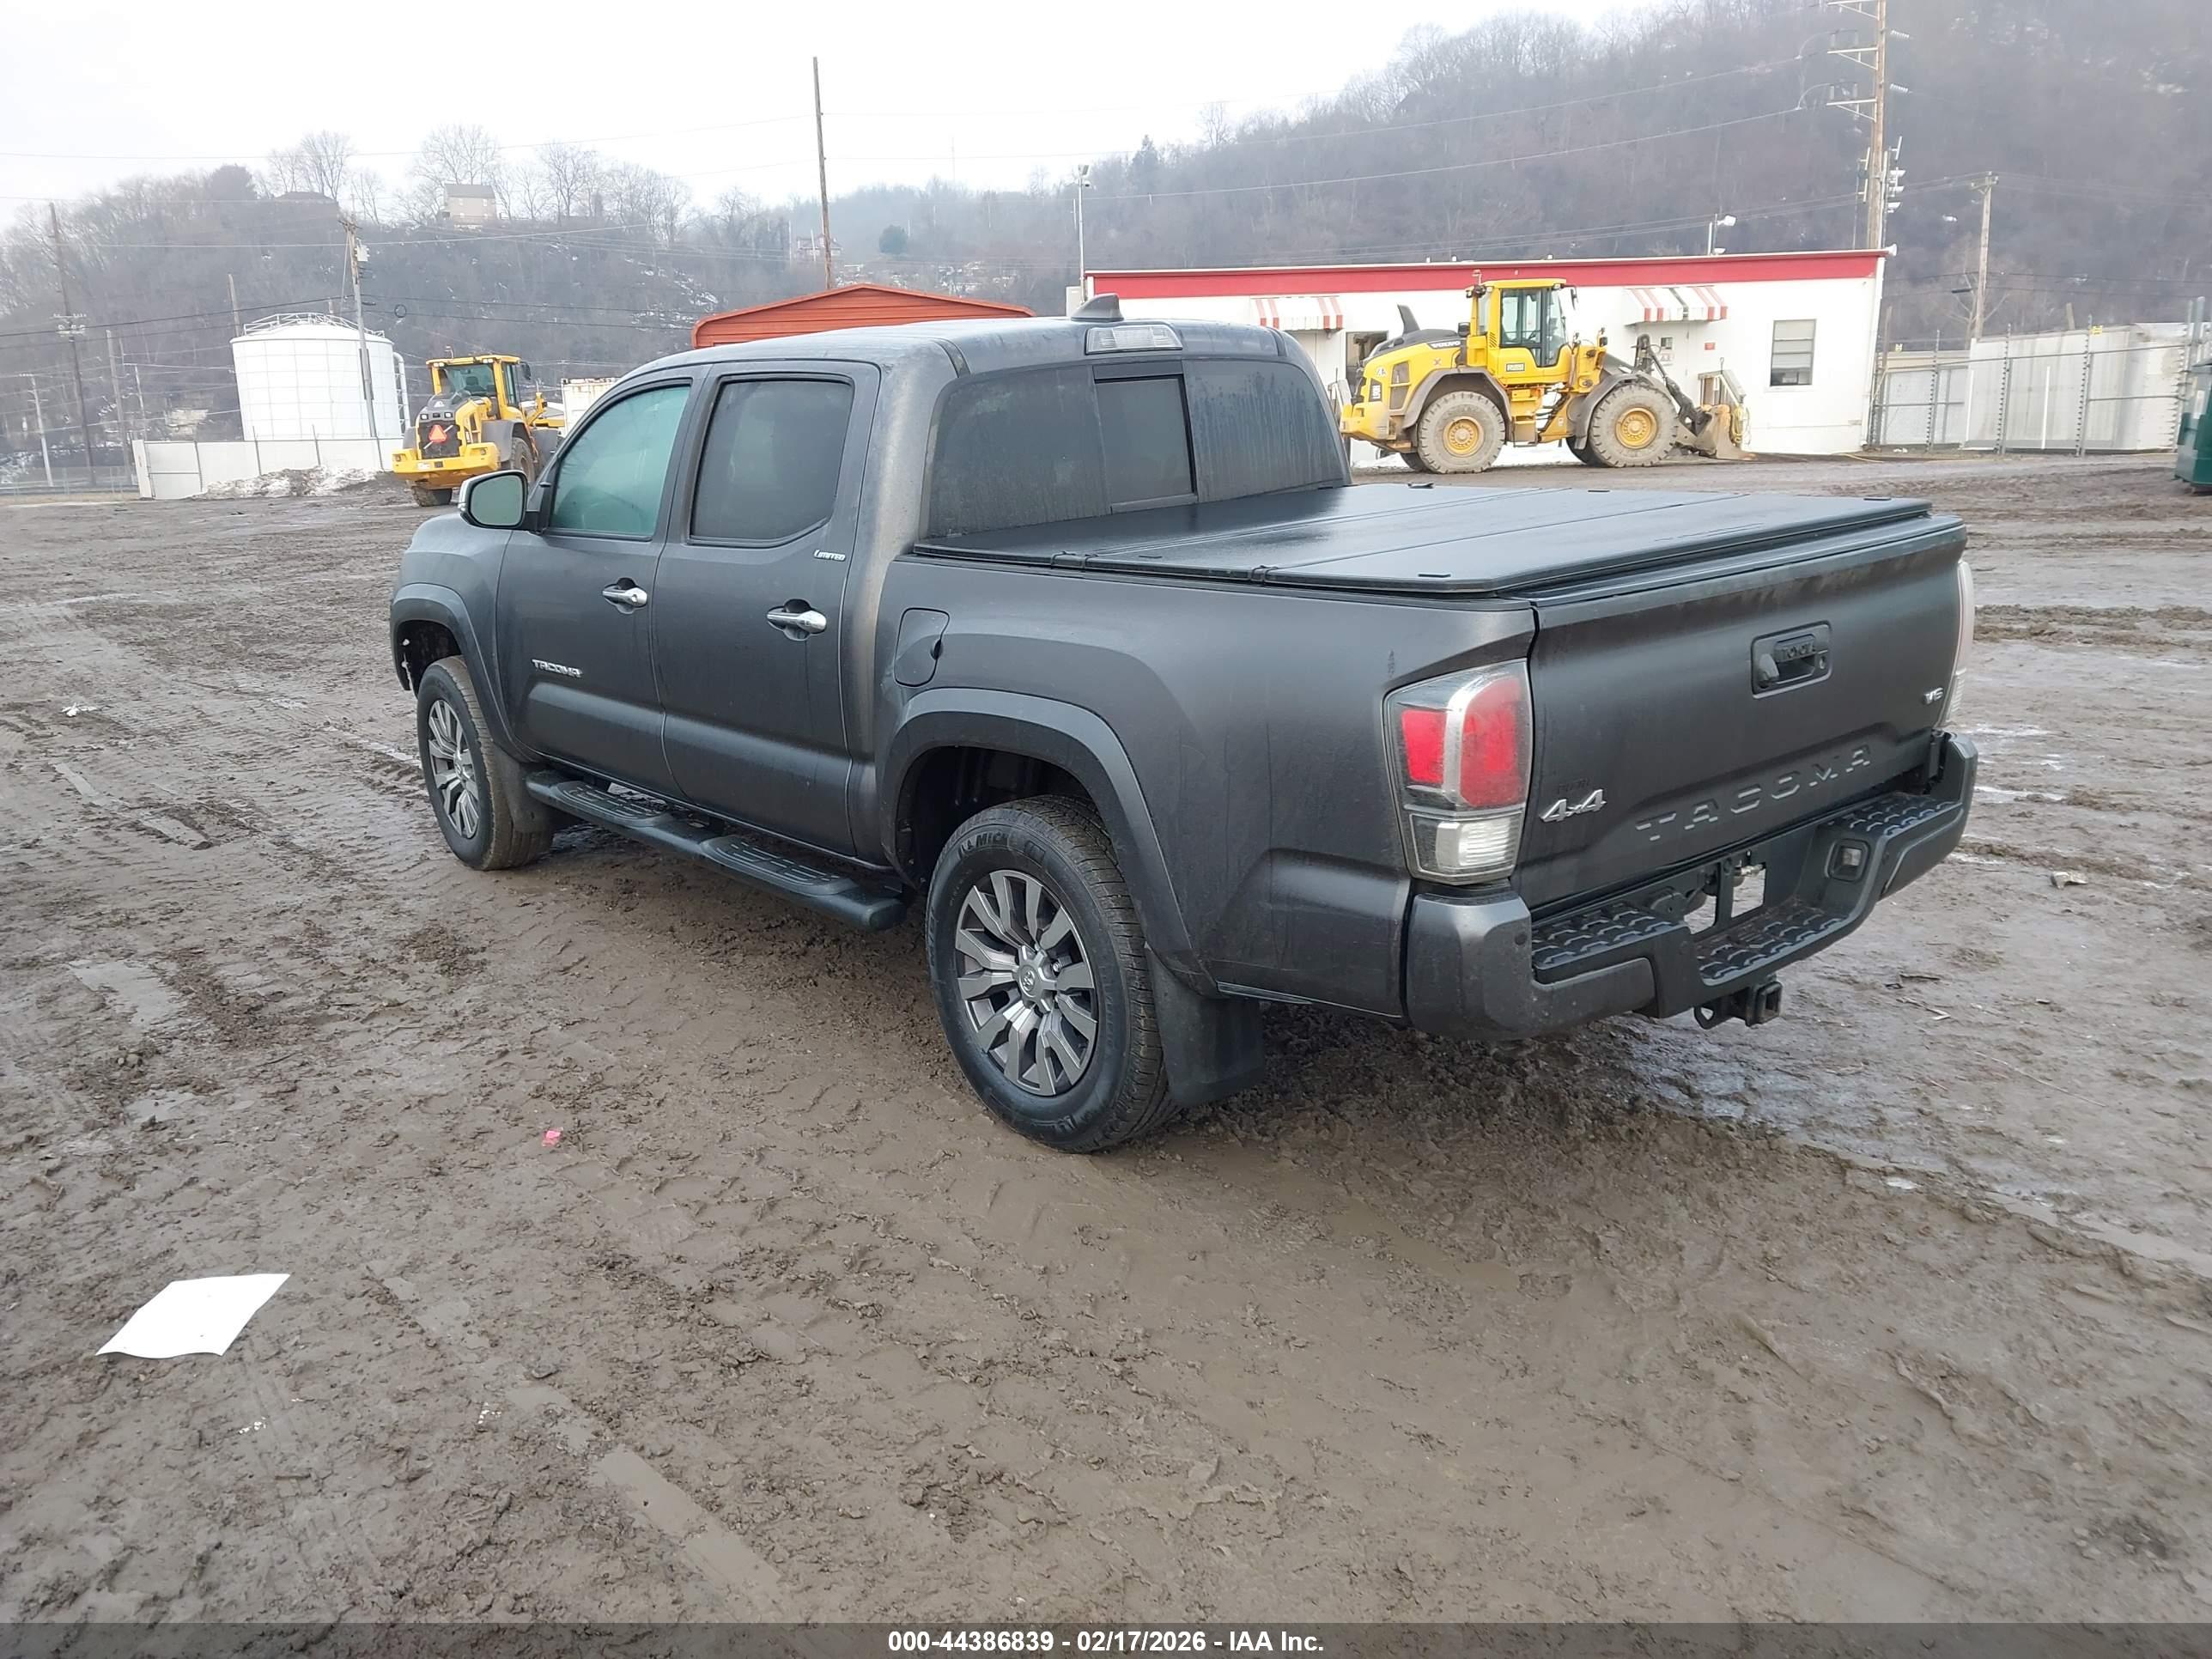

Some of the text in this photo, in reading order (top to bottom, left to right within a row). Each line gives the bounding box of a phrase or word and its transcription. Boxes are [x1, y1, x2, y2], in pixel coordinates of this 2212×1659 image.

[532, 659, 583, 678] TACOMA
[1925, 687, 1944, 704] V6
[1636, 744, 1871, 841] TACOMA
